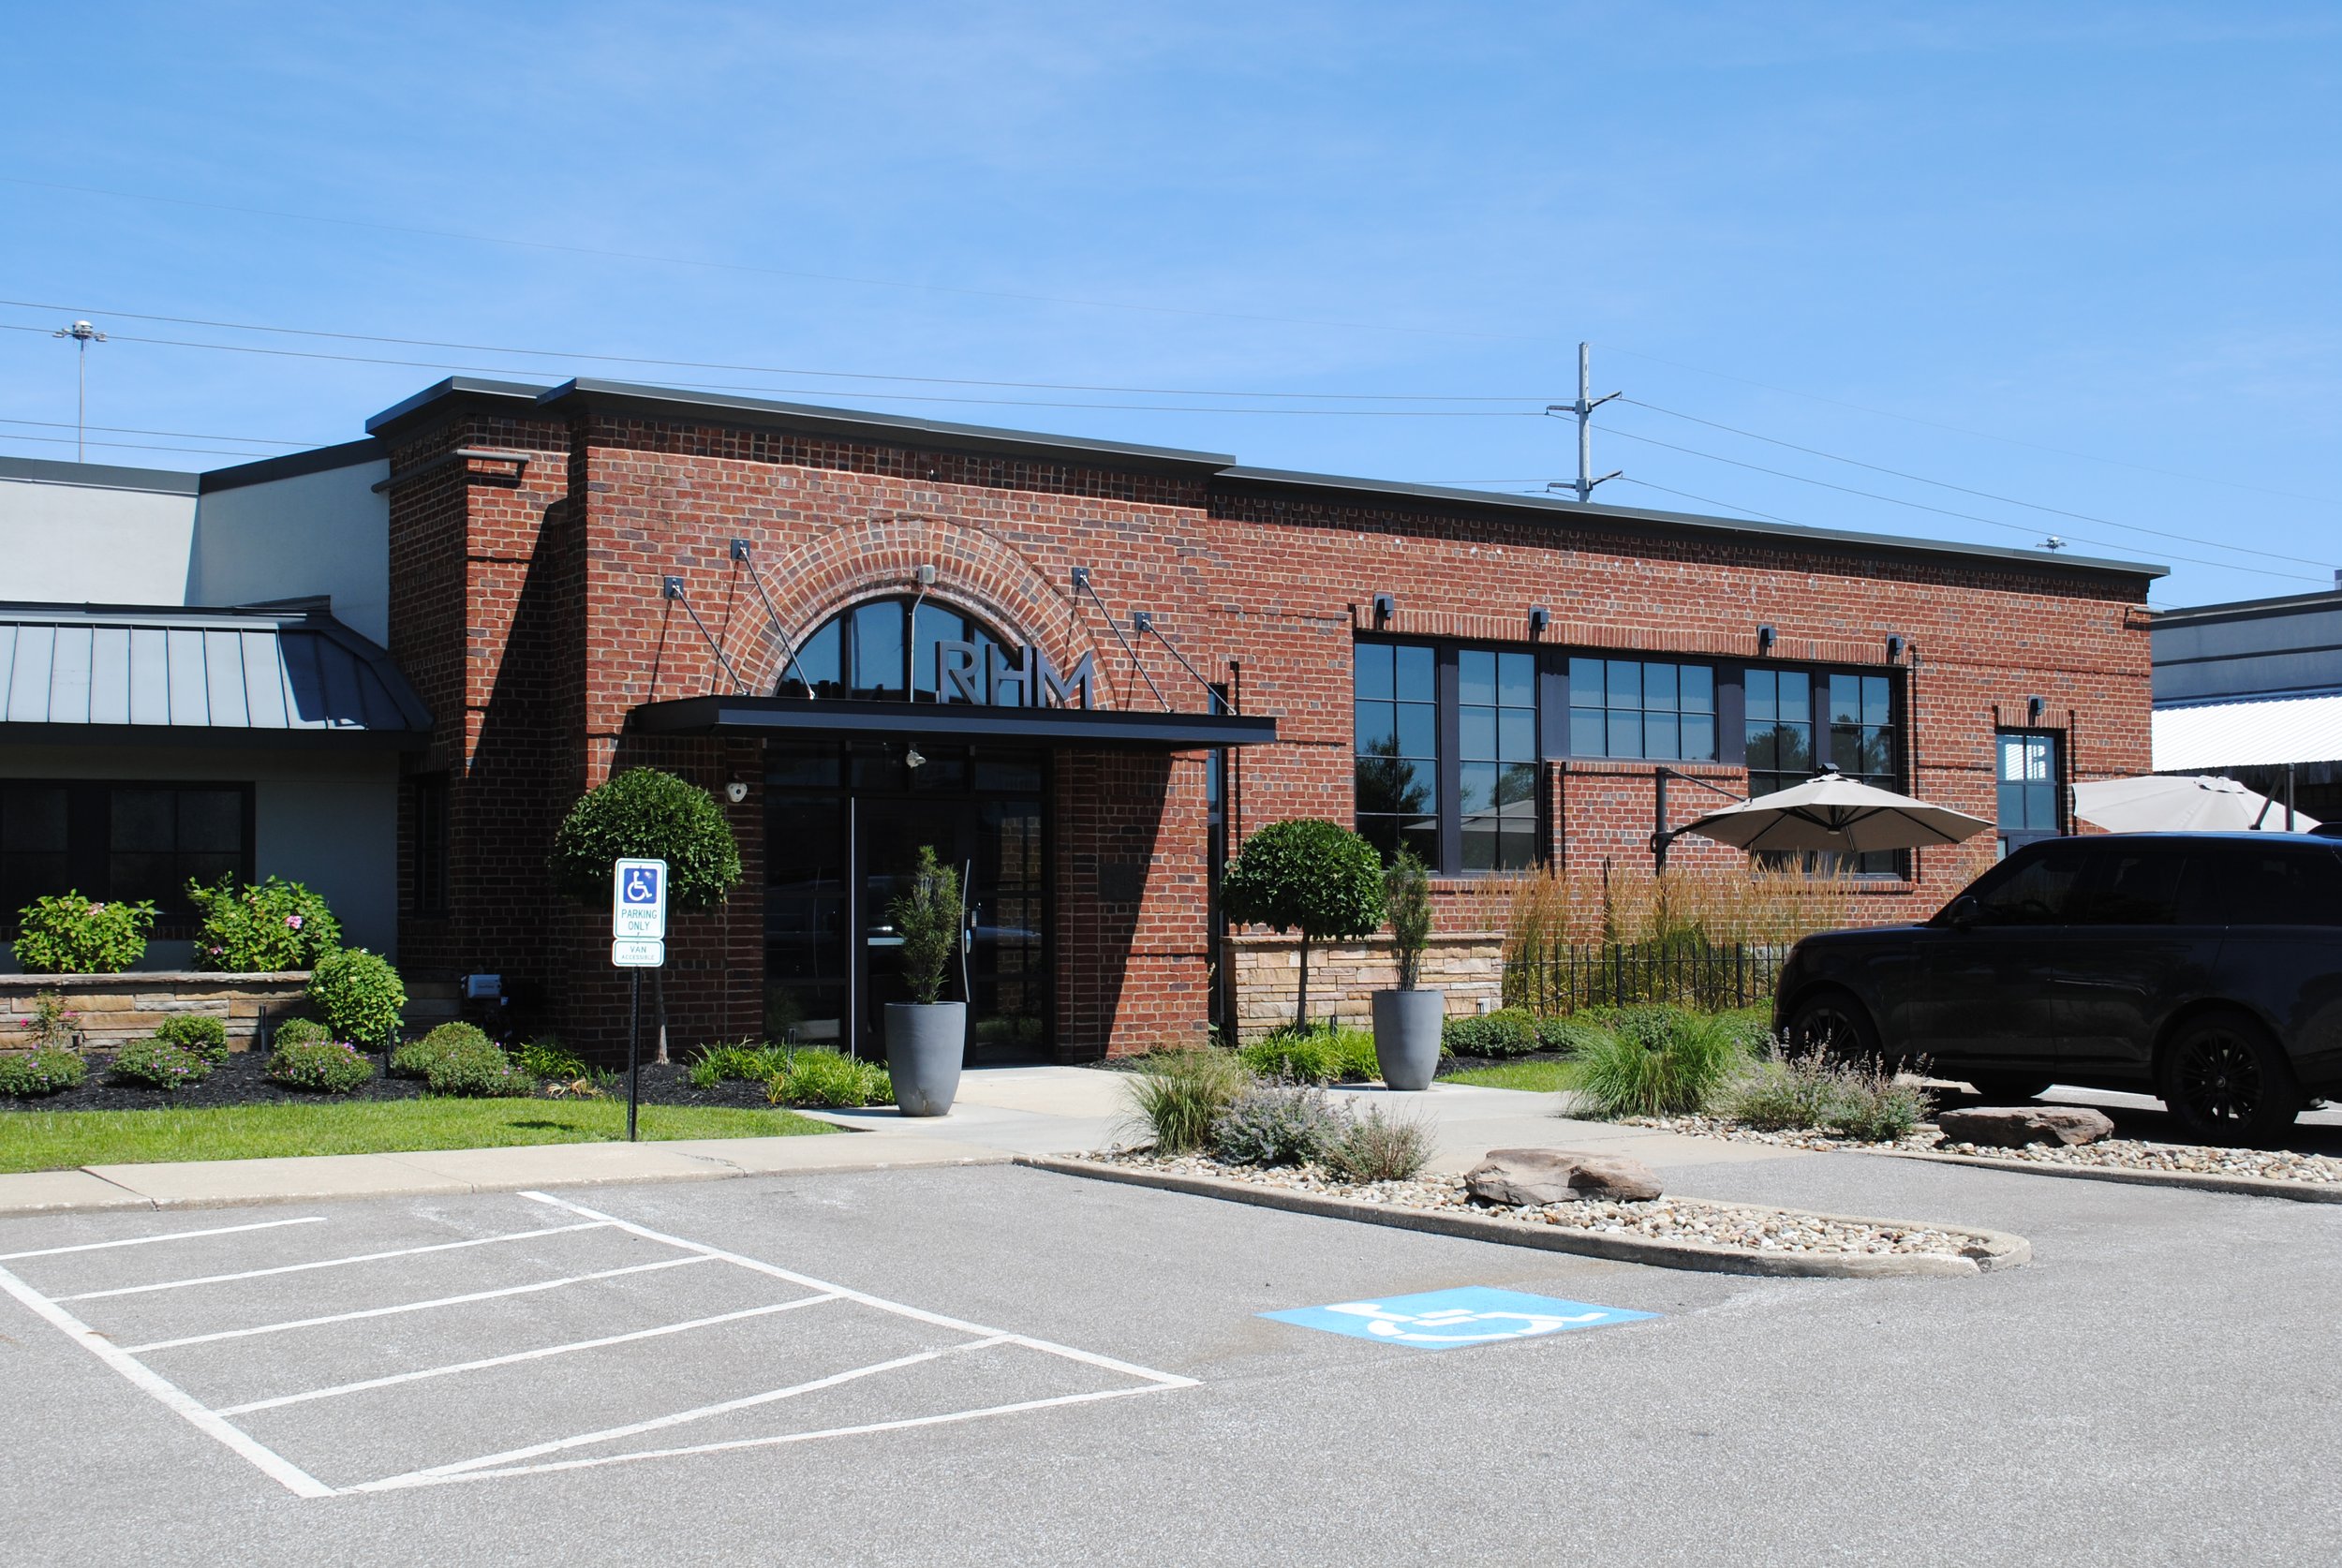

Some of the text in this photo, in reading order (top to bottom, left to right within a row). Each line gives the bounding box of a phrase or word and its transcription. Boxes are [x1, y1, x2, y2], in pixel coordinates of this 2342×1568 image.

[935, 640, 1093, 710] RHM
[621, 909, 658, 920] PARKING
[628, 921, 650, 931] ONLY
[630, 945, 647, 954] VAN
